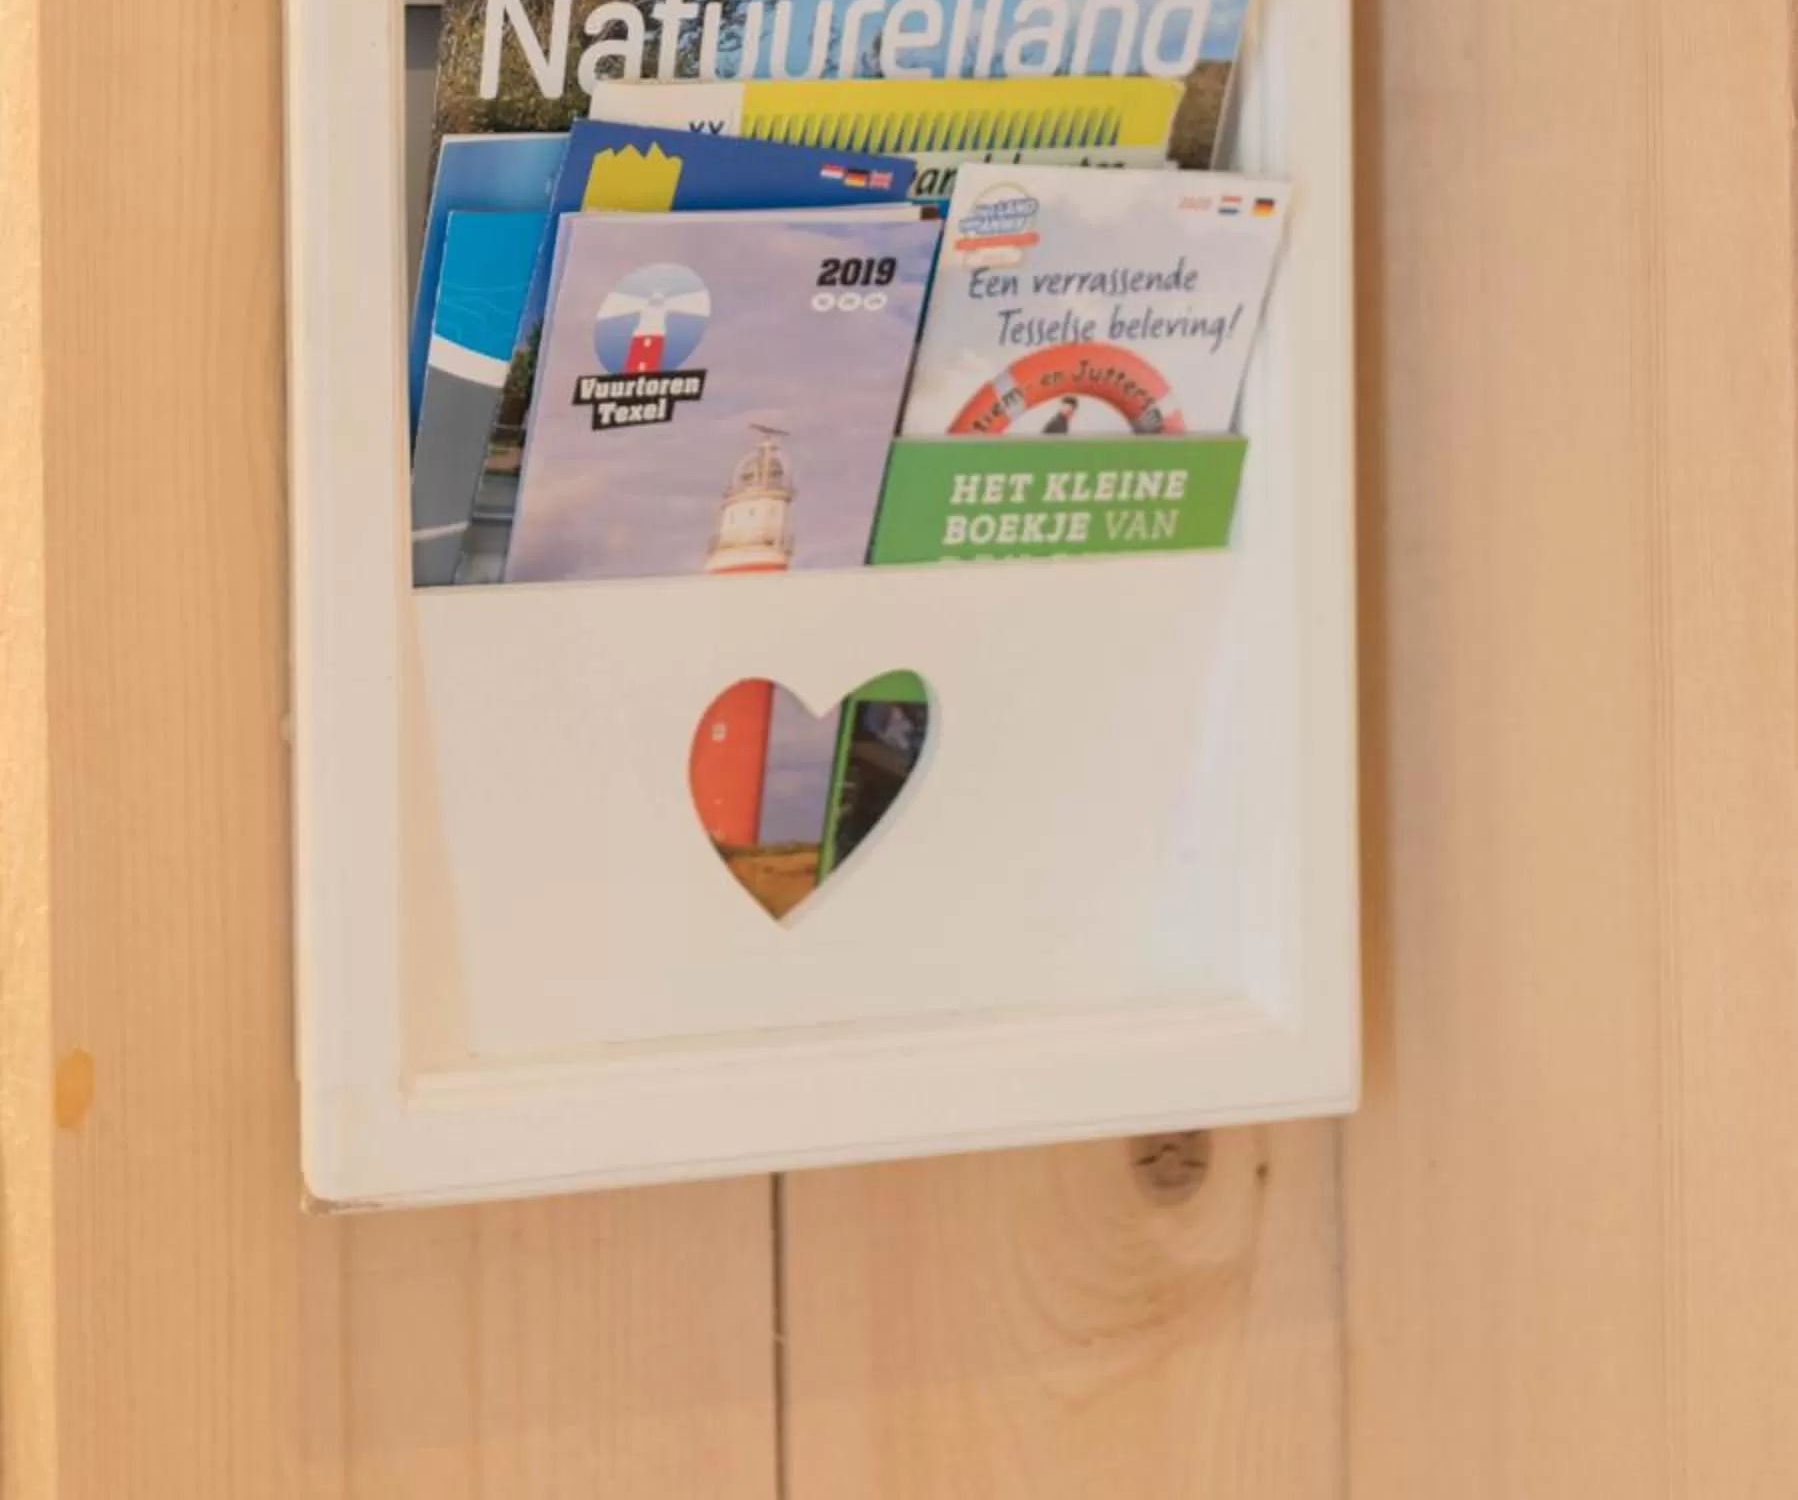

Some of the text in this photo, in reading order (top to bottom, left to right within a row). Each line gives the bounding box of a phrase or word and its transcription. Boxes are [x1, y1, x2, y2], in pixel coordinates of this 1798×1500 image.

[816, 256, 898, 287] 2019
[969, 266, 1018, 299] Een
[1033, 257, 1200, 297] verrassende
[998, 304, 1243, 353] Tesselse beleving!
[579, 375, 701, 401] Vuurtoren
[597, 401, 667, 426] Texel
[950, 469, 1188, 505] HET KLEINE
[942, 509, 1181, 546] BOEKJE VAN
